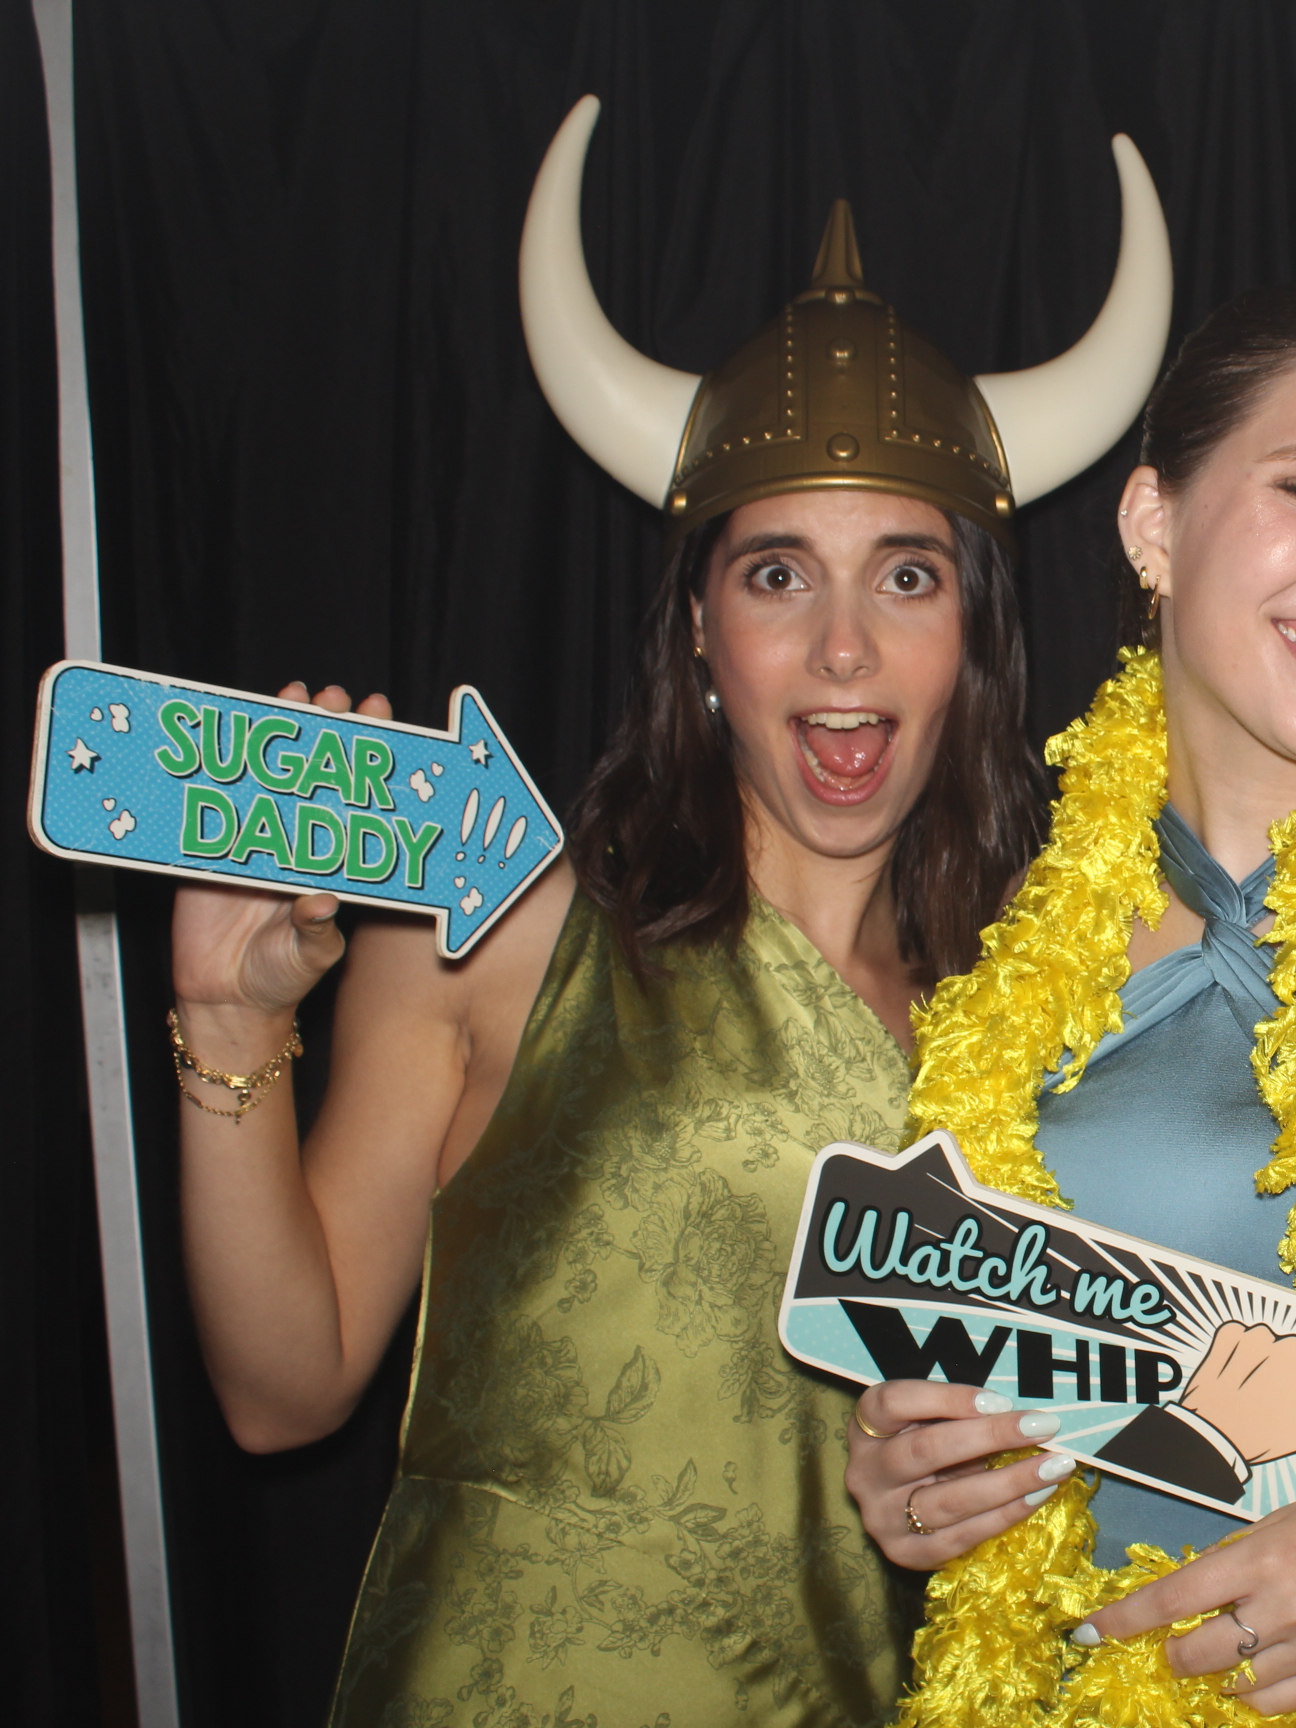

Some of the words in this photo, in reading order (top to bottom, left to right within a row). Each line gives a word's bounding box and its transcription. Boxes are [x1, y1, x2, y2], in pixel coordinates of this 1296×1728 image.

[154, 699, 394, 809] SUGAR
[180, 784, 442, 889] DADDY
[822, 1201, 1055, 1303] Watch
[1073, 1271, 1177, 1326] me
[837, 1297, 1183, 1406] WHIP
